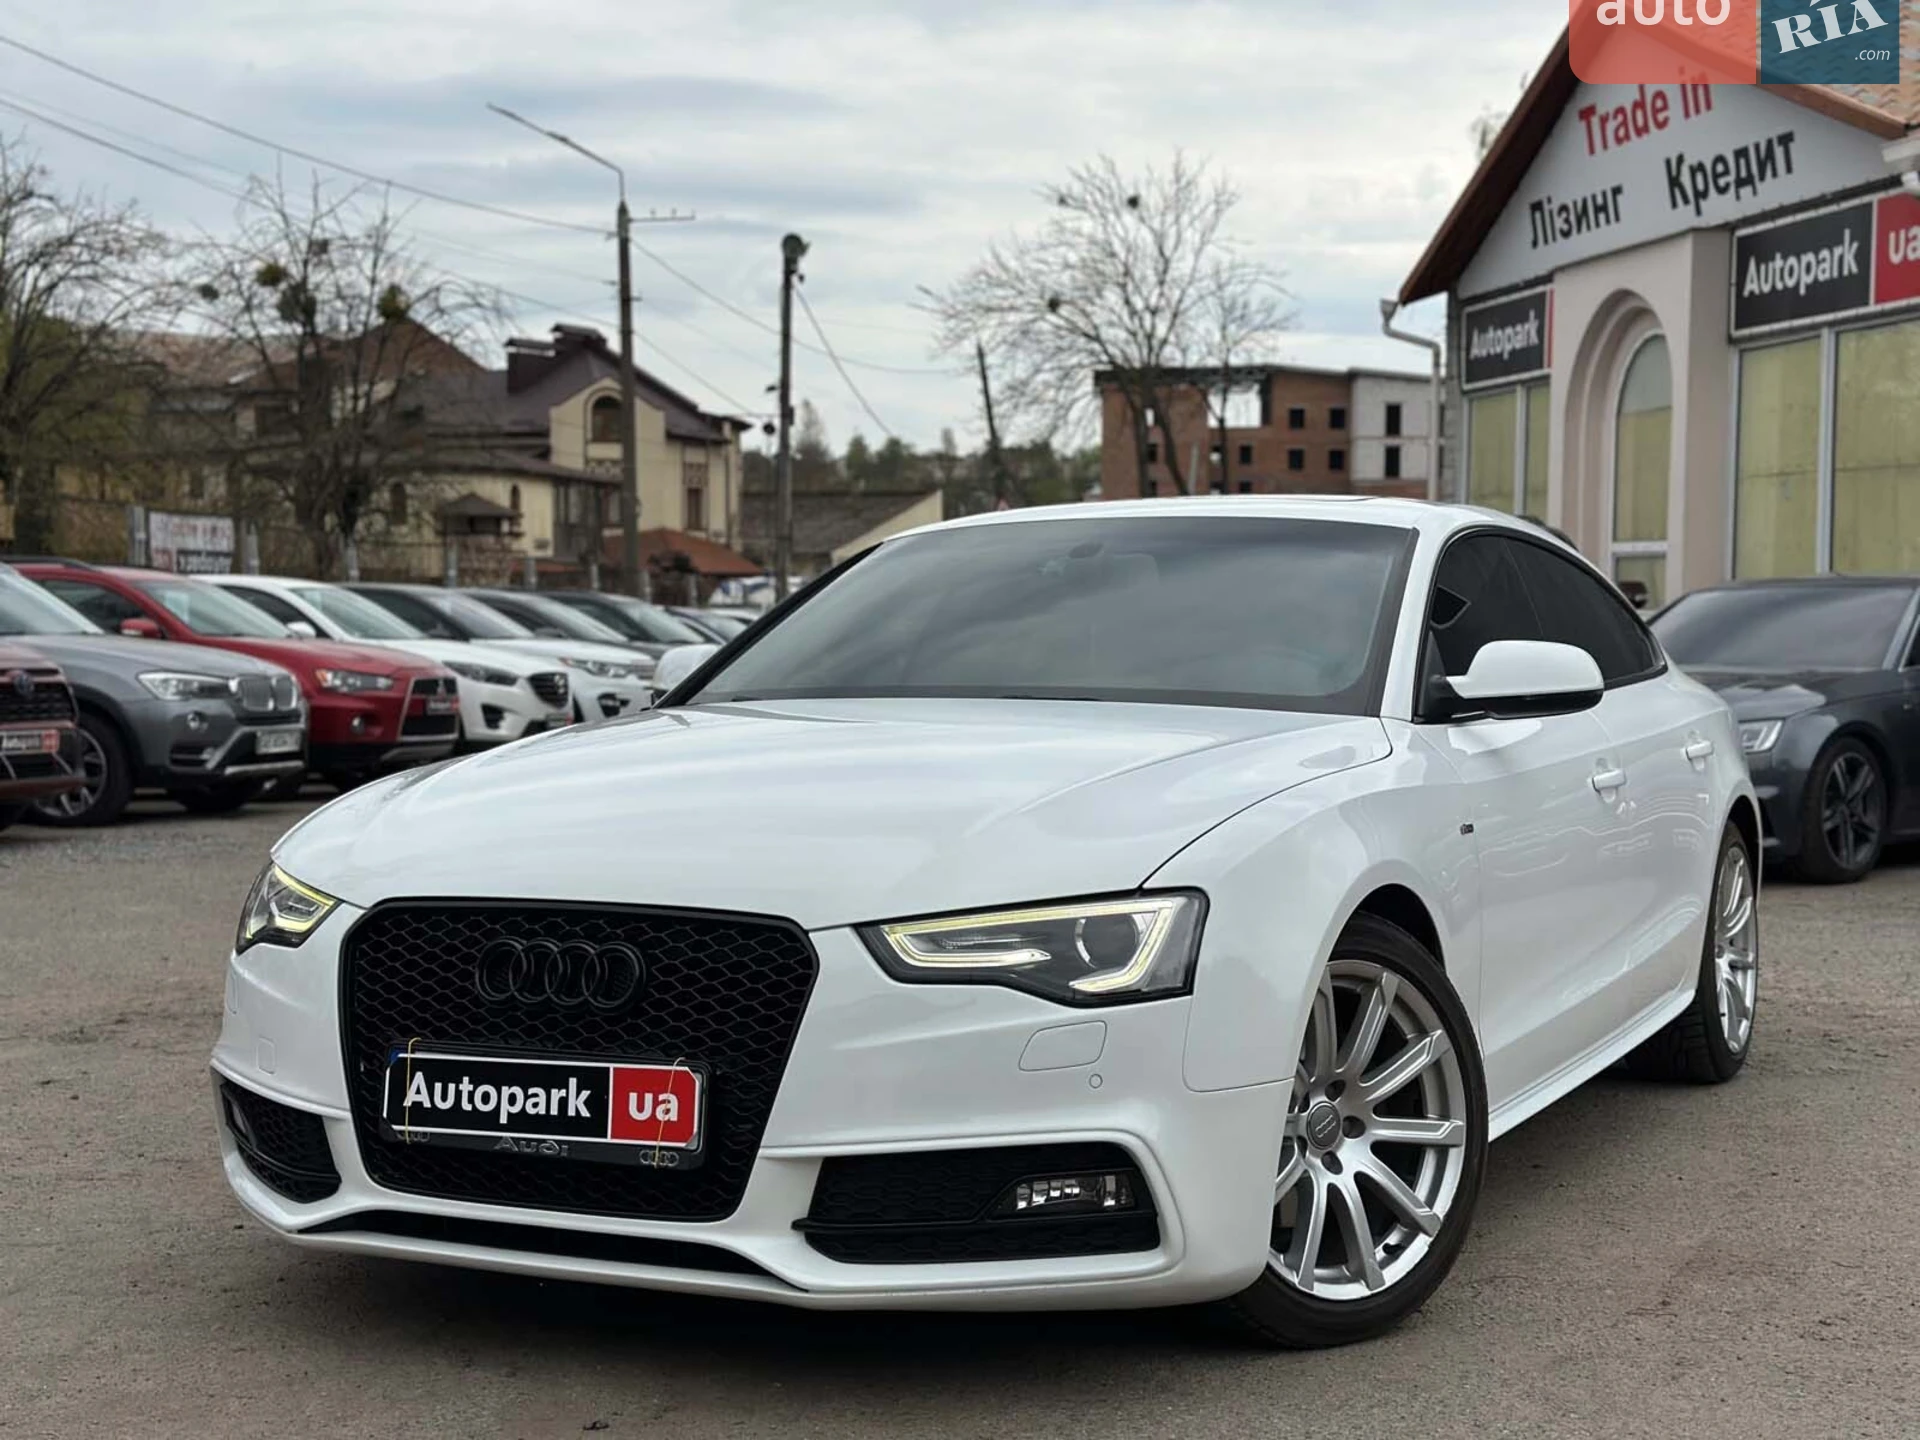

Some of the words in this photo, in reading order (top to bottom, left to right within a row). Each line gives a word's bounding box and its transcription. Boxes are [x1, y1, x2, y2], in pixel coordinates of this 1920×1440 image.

[1578, 82, 1670, 156] Trade
[1678, 66, 1714, 121] in
[1529, 184, 1623, 250] Лізинг
[1664, 130, 1795, 217] Кредит
[1743, 227, 1860, 298] Autopark
[1468, 309, 1540, 361] Autopark
[402, 1071, 592, 1124] Autopark
[627, 1090, 679, 1122] ua
